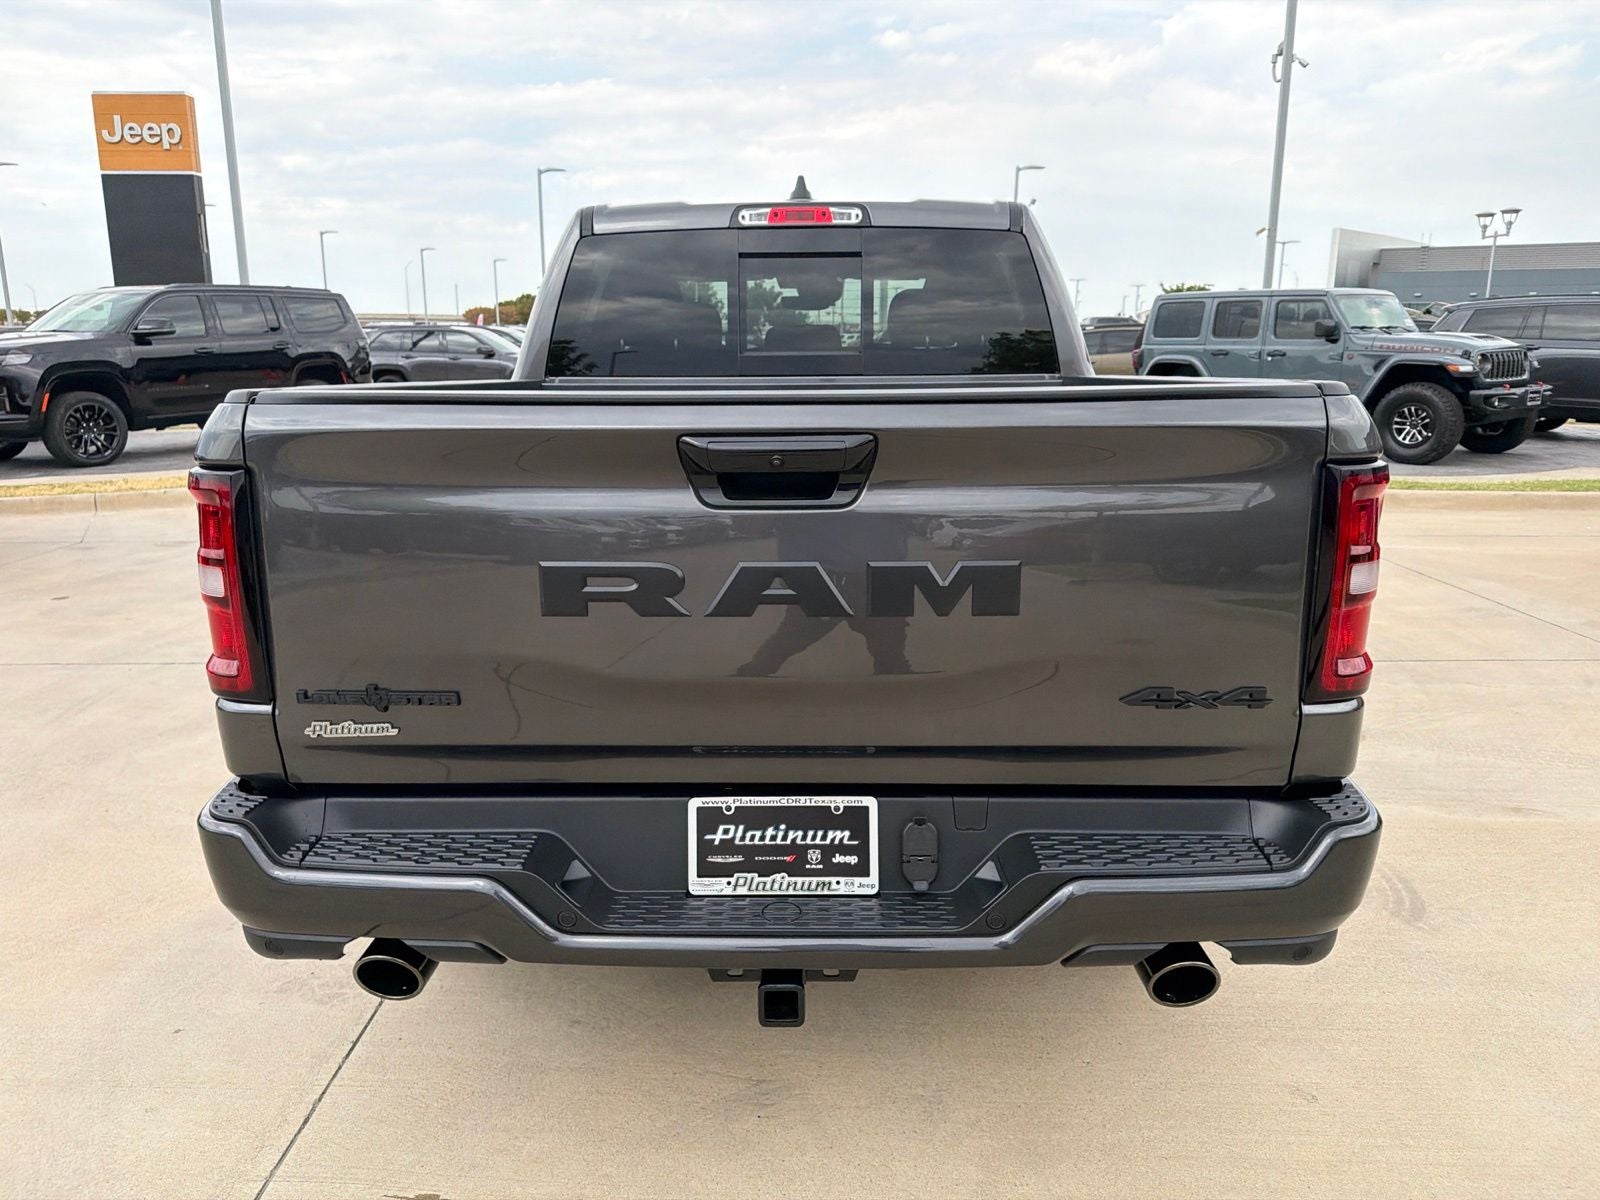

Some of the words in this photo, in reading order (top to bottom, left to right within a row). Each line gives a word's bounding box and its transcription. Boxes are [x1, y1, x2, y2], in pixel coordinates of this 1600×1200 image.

[101, 114, 182, 151] Jeep
[1376, 343, 1456, 353] RUBICON
[538, 560, 1022, 617] RAM
[305, 721, 398, 738] Platinum
[701, 797, 863, 806] www.PlatinumCDRJTexas.com
[704, 824, 858, 845] Platinum
[832, 853, 858, 865] Jeep
[732, 875, 840, 892] Platinum
